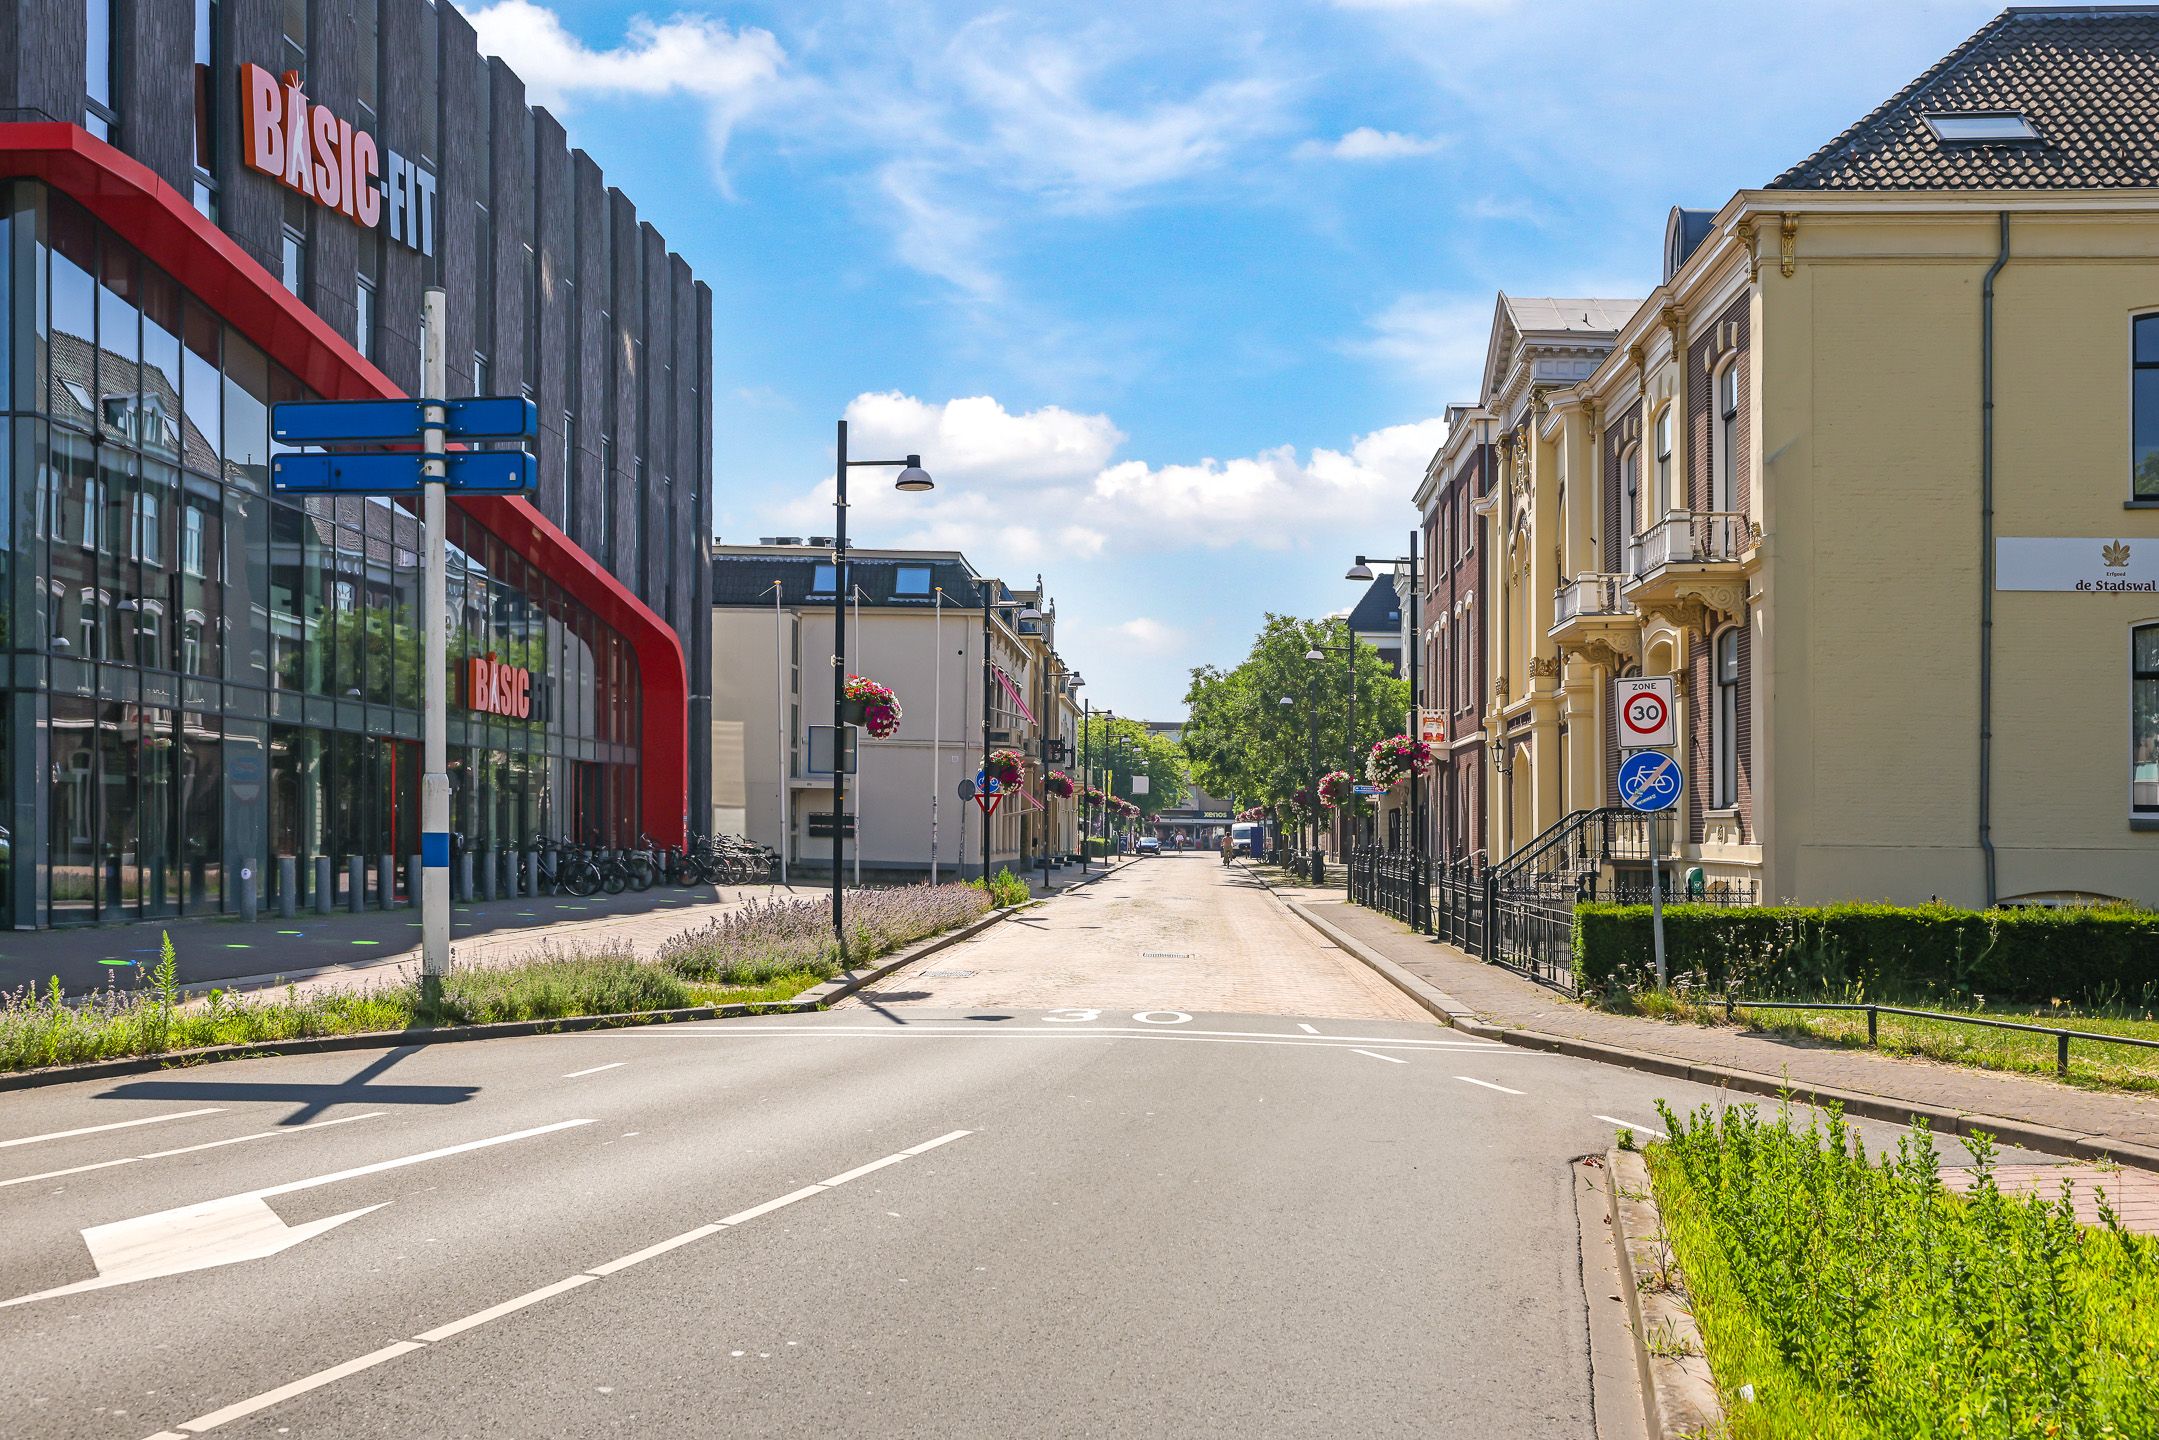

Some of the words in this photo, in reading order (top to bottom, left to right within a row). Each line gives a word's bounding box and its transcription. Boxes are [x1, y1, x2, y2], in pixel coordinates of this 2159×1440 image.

[245, 62, 436, 258] BASIC-FIT
[2075, 579, 2092, 591] de
[2095, 580, 2157, 591] Stadswal
[1632, 705, 1659, 721] 30
[1041, 1008, 1193, 1024] 30
